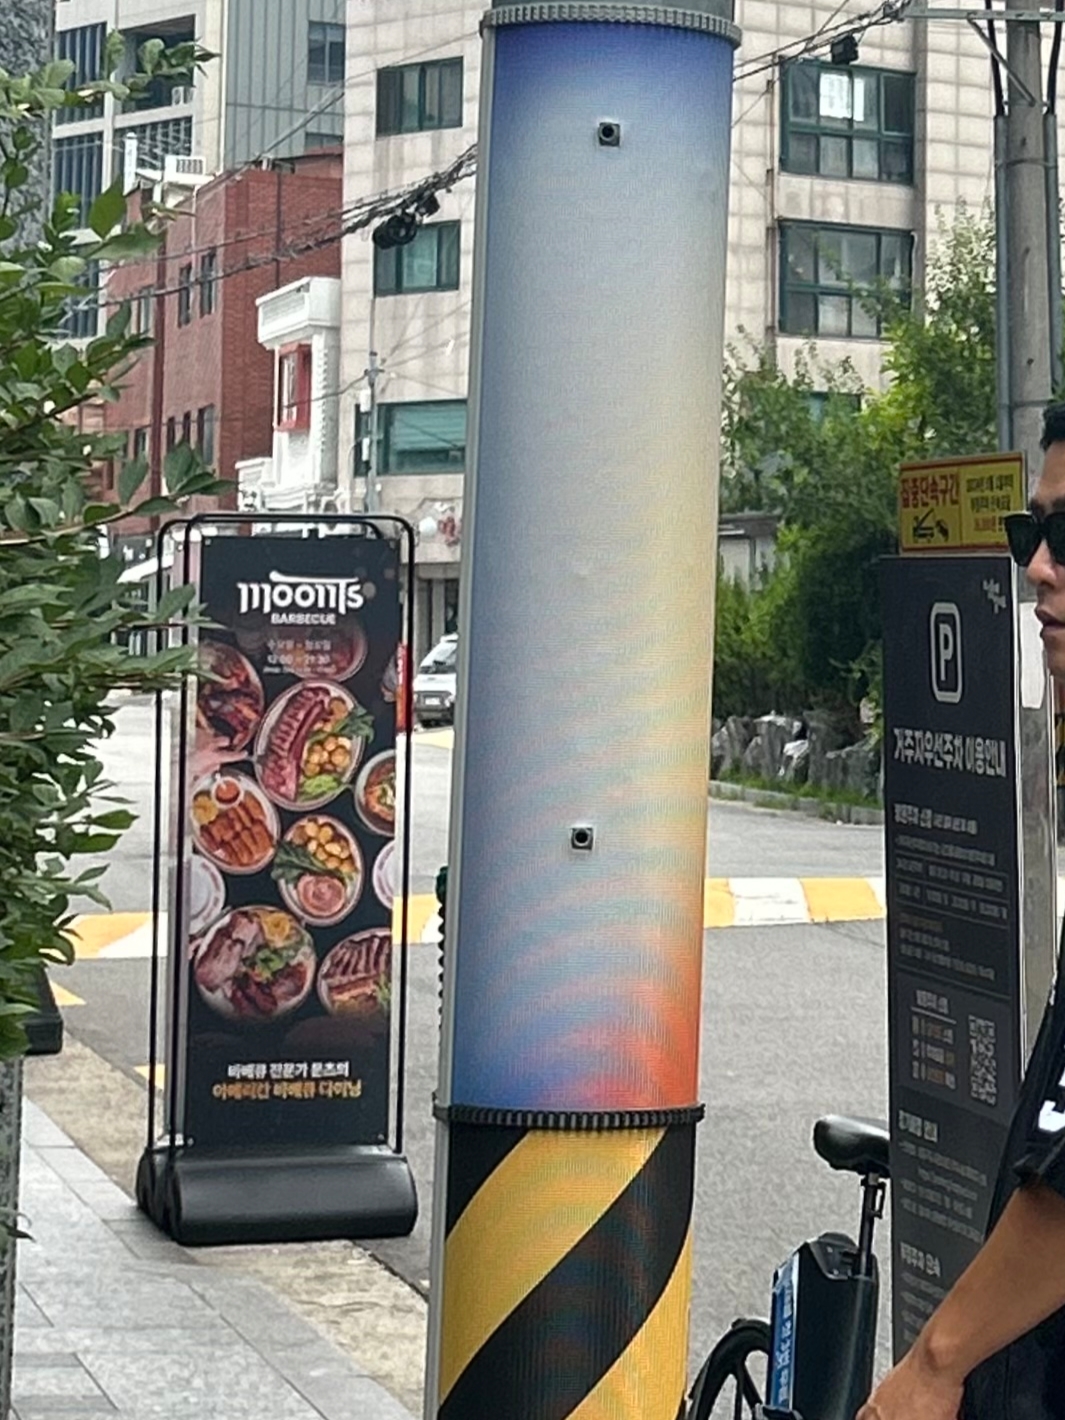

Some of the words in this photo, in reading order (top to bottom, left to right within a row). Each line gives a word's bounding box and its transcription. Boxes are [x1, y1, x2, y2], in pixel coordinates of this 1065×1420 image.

[271, 613, 336, 624] BARBECUE
[939, 623, 953, 680] P
[894, 728, 963, 771] 거주자우선주차
[966, 736, 1007, 778] 이용안내
